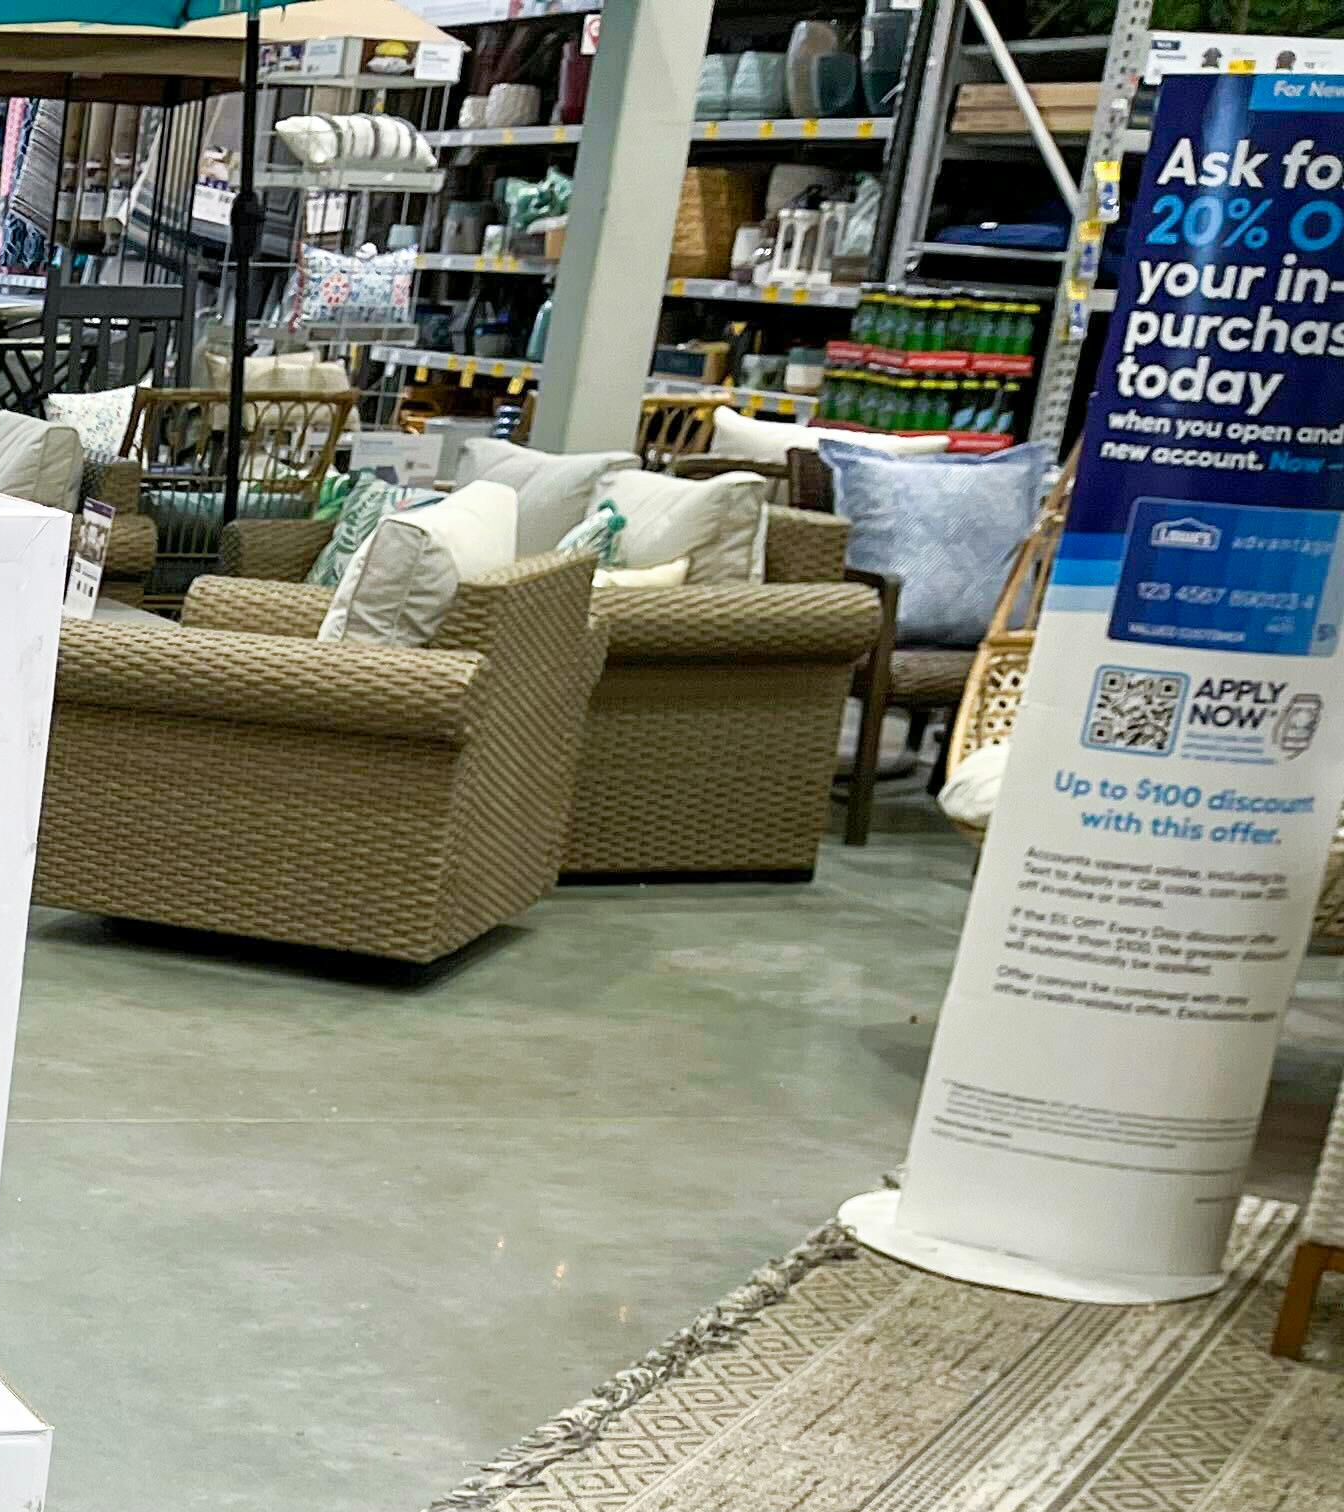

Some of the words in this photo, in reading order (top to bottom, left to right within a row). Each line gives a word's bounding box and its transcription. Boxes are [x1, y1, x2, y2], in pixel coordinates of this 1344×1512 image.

[1273, 80, 1304, 97] For
[1156, 137, 1268, 188] Ask
[1282, 139, 1344, 190] fo
[1146, 194, 1273, 248] 20%
[1137, 260, 1266, 305] your
[1123, 305, 1344, 357] purchas
[1117, 354, 1284, 416] today
[1108, 409, 1171, 434] when
[1175, 418, 1223, 439] you
[1226, 422, 1292, 444] open
[1296, 424, 1344, 444] and
[1100, 441, 1151, 462] new
[1152, 447, 1264, 472] account.
[1194, 678, 1288, 704] APPLY
[1054, 769, 1092, 798] Up
[1100, 779, 1127, 801] to
[1136, 777, 1202, 809] $100
[1081, 809, 1141, 834] with
[1151, 816, 1203, 842] this
[1209, 820, 1283, 845] offer.
